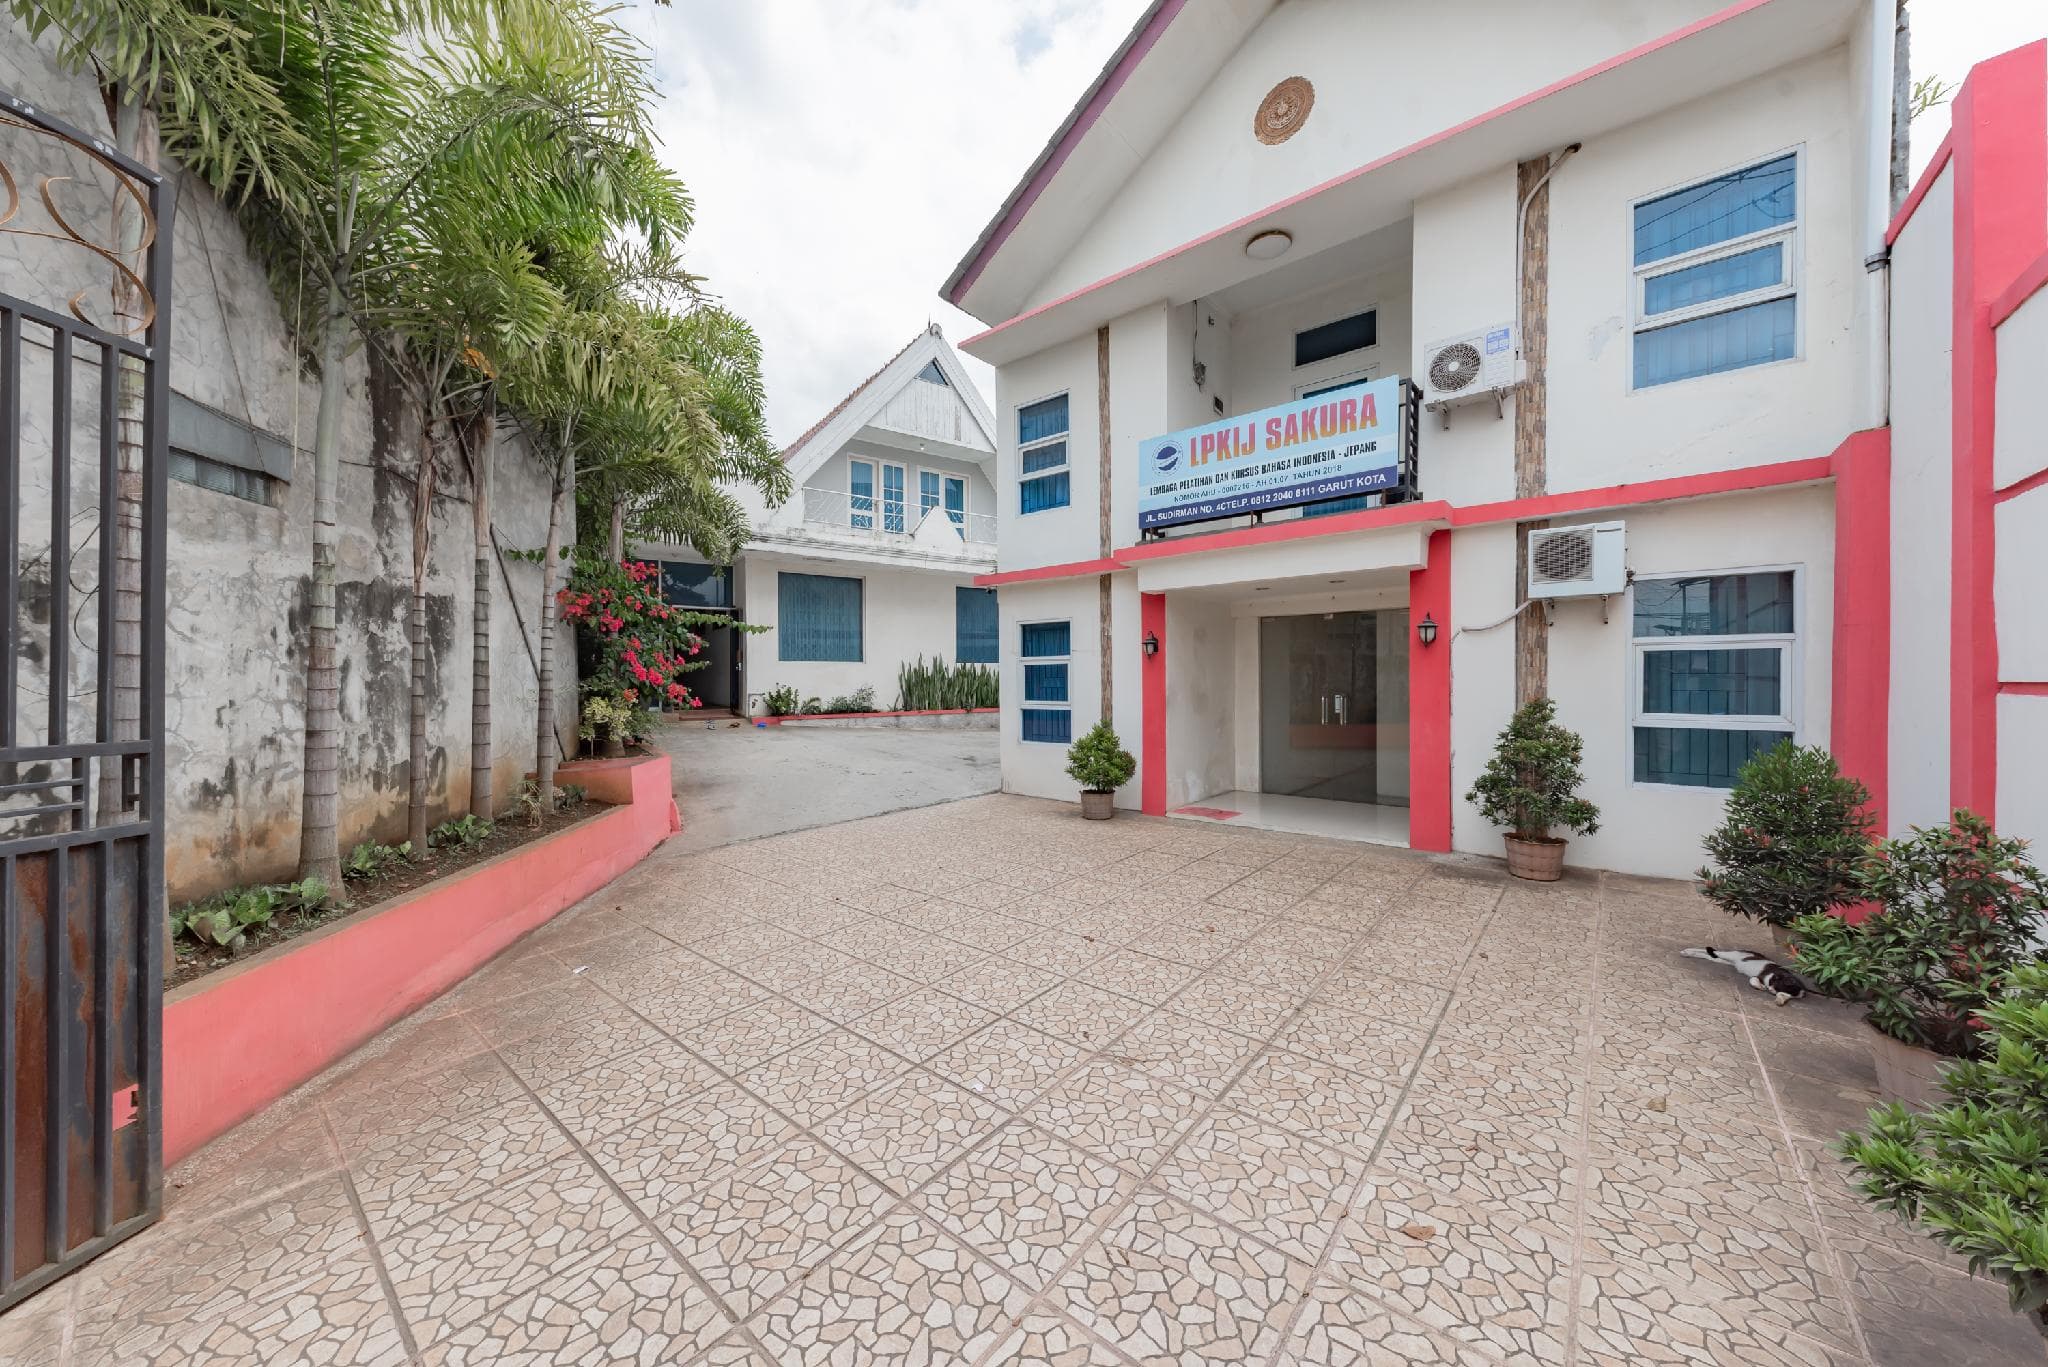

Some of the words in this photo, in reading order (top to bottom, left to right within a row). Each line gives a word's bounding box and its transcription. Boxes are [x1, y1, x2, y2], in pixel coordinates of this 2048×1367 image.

[1190, 422, 1256, 467] LPKIJ
[1265, 393, 1378, 451] SAKURA
[1150, 483, 1178, 496] LEMBAGA
[1179, 476, 1213, 490] PELATIHAN
[1215, 471, 1229, 484] DAN
[1231, 465, 1259, 480] KURSUS
[1261, 459, 1291, 475] BAHASA
[1293, 449, 1336, 468] INDONESIA
[1343, 441, 1377, 458] JEPANG
[1292, 468, 1321, 480] TAHUN
[1323, 464, 1342, 474] 2018
[1157, 507, 1198, 520] SUDIRMAN
[1199, 504, 1214, 513] NO.
[1250, 494, 1271, 505] 0812
[1272, 490, 1294, 502] 2040
[1317, 478, 1355, 494] GARUT
[1356, 473, 1387, 488] KOTA
